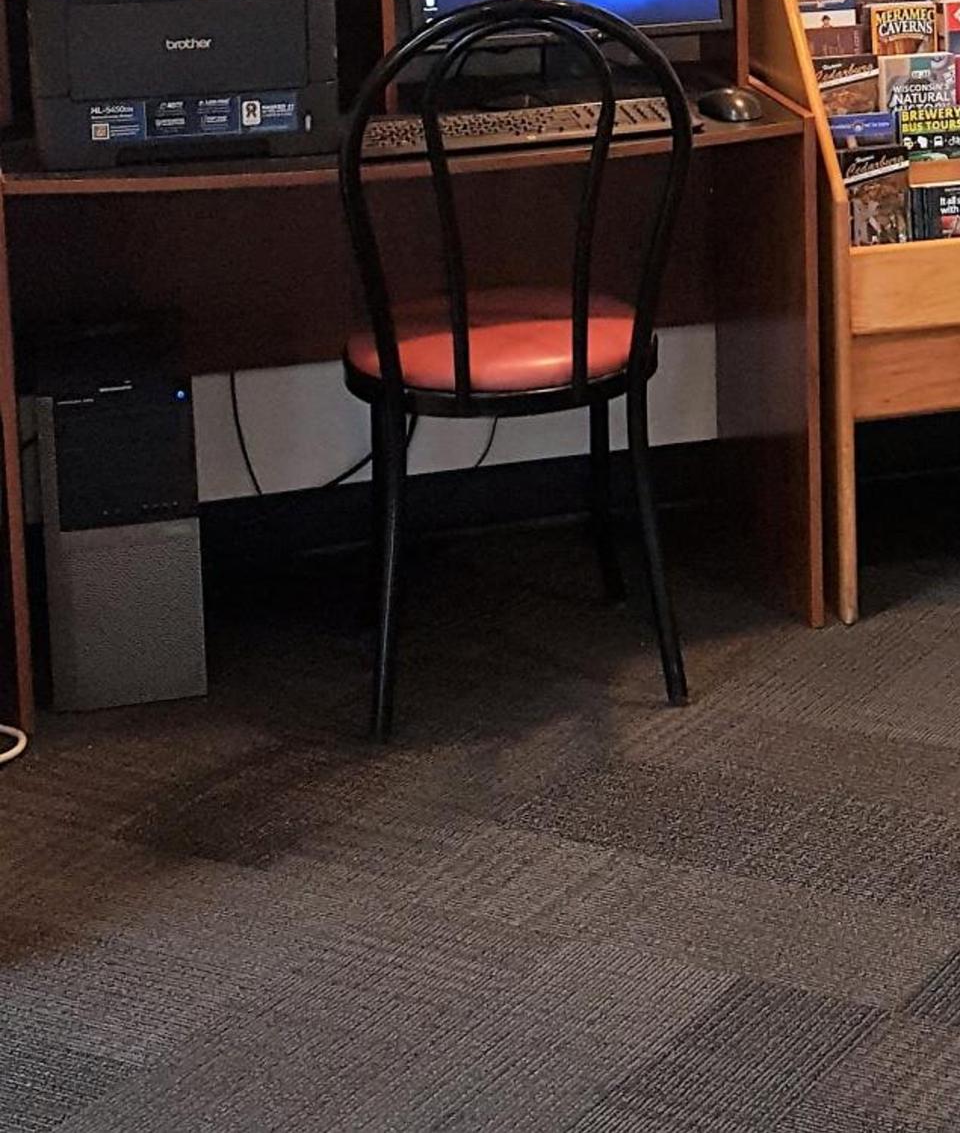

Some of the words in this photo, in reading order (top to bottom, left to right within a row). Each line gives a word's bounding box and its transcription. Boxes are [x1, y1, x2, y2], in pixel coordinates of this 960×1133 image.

[876, 7, 935, 24] MERAMEC
[879, 21, 933, 37] CAVERNS
[166, 38, 212, 50] brother
[893, 92, 949, 104] NATURAL
[902, 122, 924, 132] BUS
